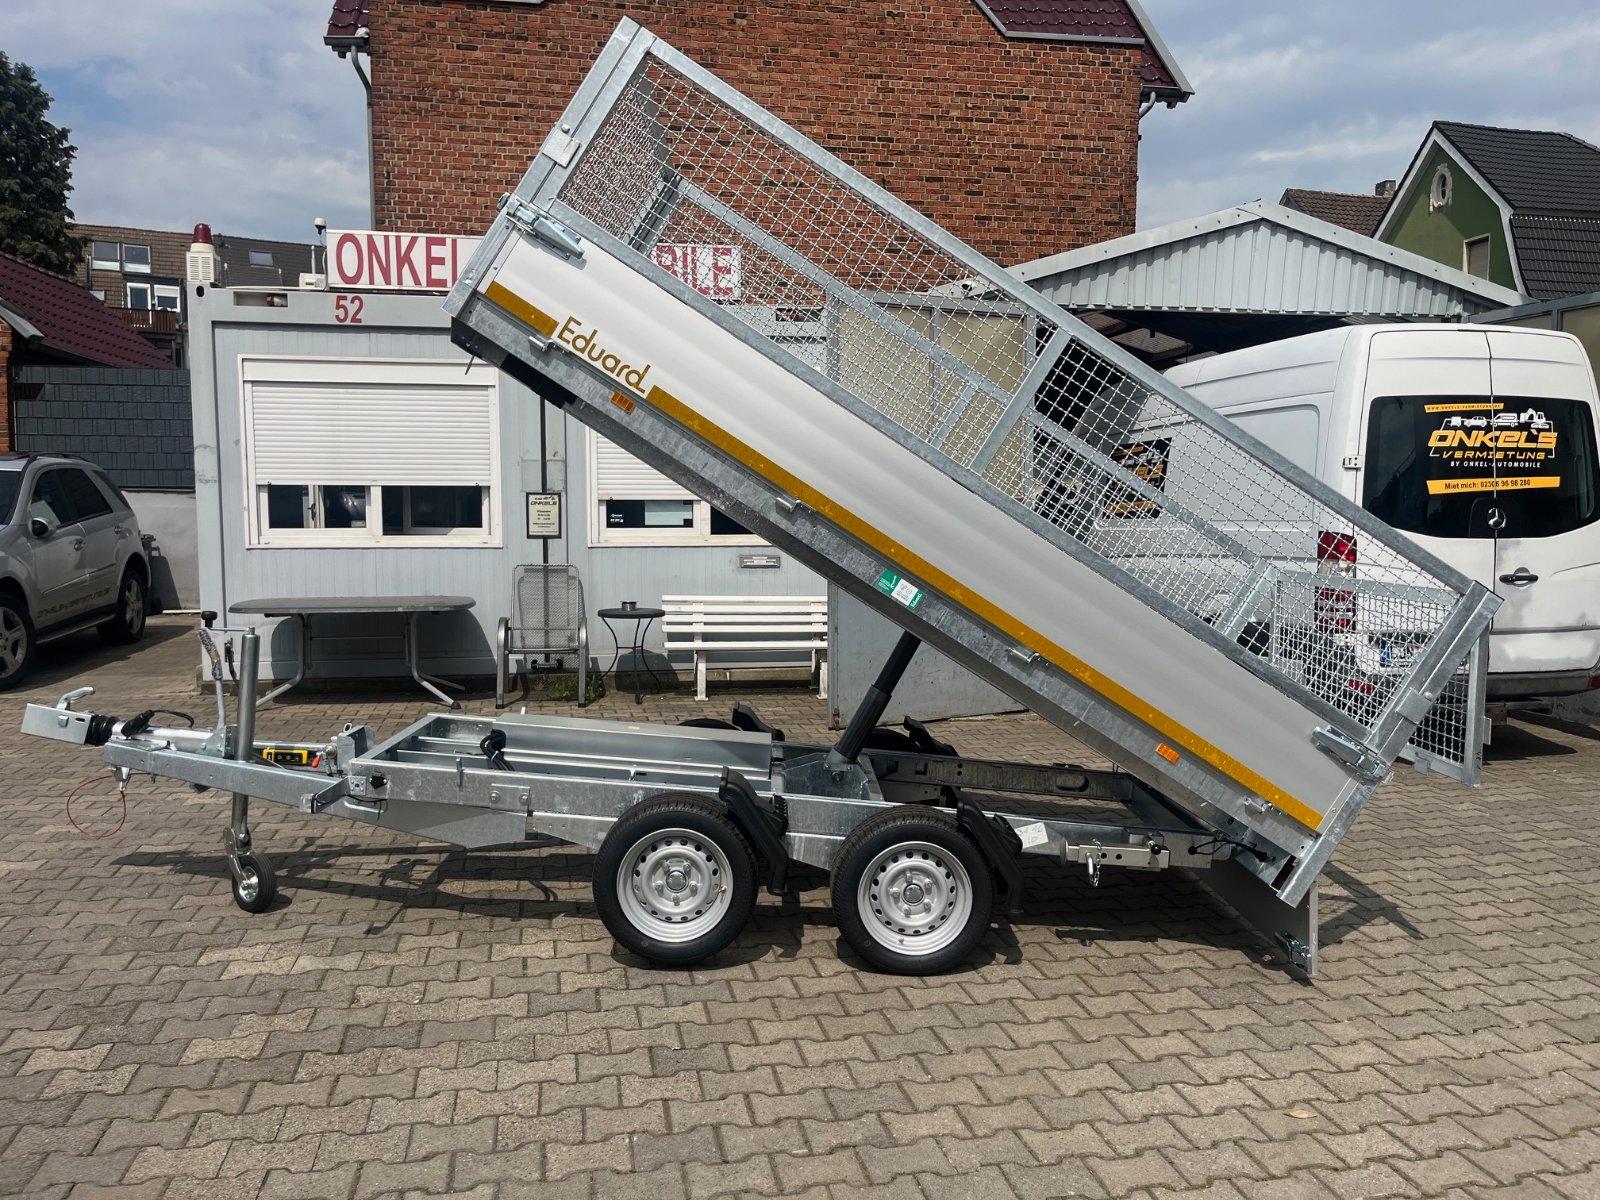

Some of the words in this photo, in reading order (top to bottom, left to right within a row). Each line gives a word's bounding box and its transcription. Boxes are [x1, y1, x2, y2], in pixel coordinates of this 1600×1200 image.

[335, 295, 364, 323] 52
[557, 316, 651, 394] Eduard
[1442, 451, 1546, 460] VERMIETUNG
[1444, 482, 1460, 490] Miet
[1460, 481, 1479, 489] mich:
